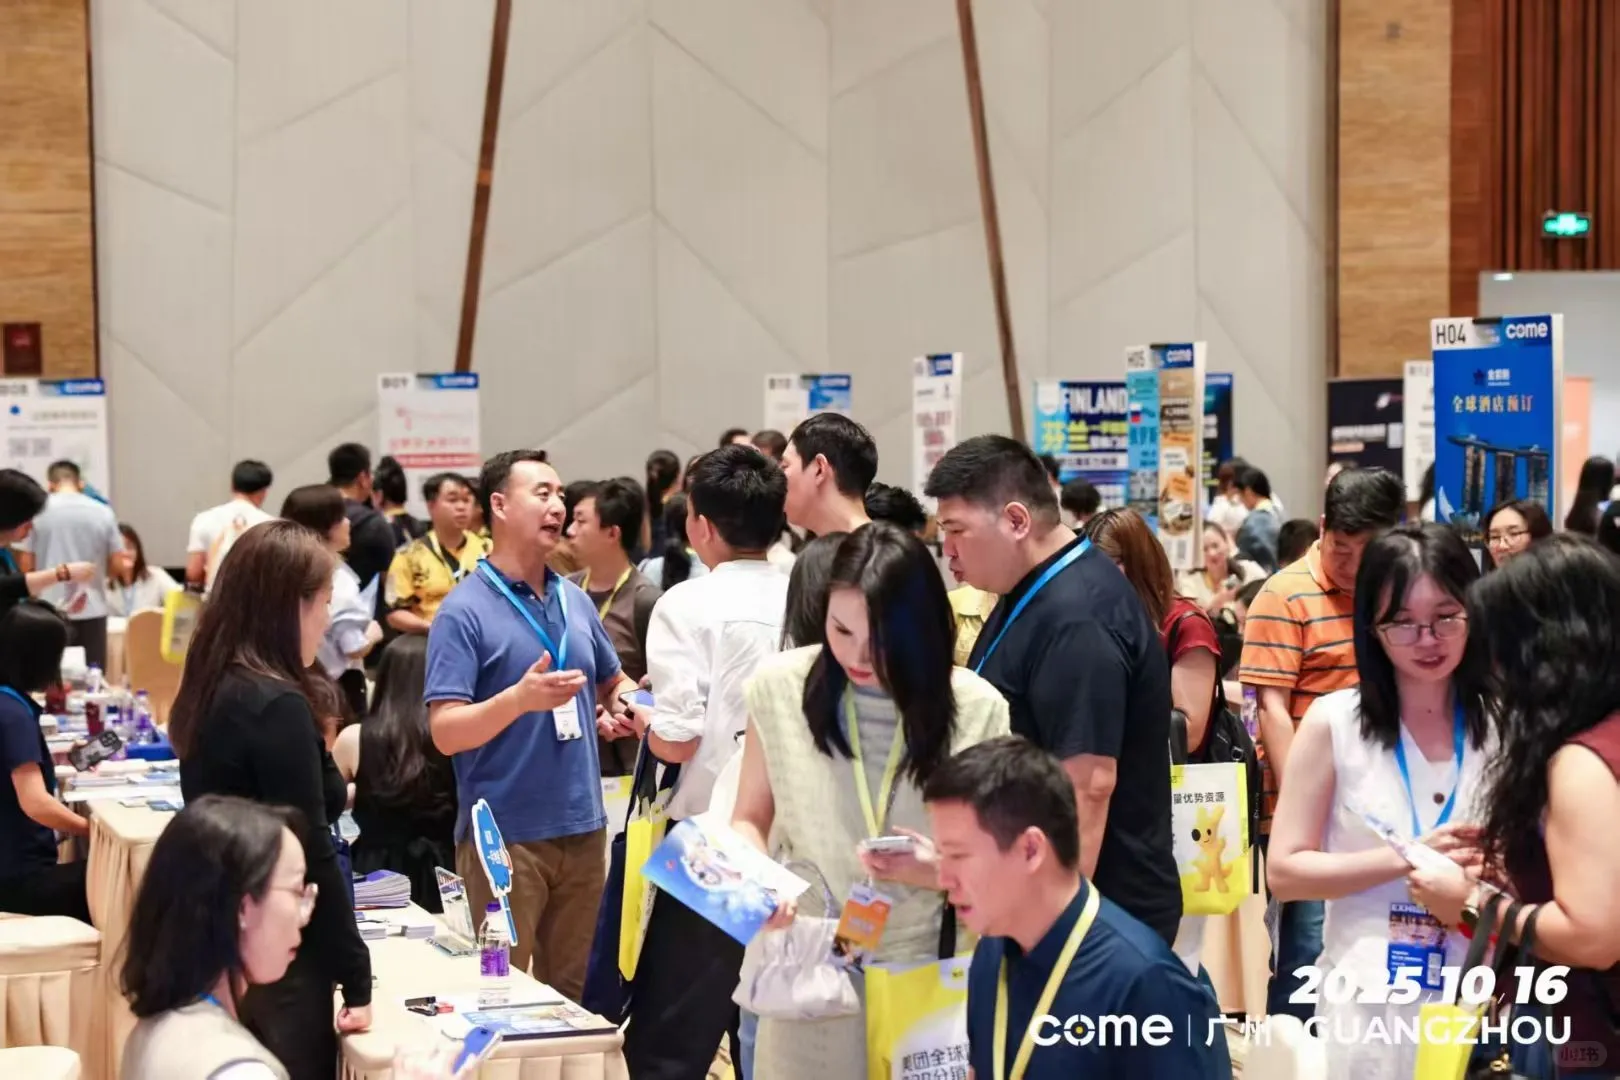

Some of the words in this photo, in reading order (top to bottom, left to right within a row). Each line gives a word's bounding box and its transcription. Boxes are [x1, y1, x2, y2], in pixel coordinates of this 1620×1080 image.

[1436, 324, 1467, 345] H04
[1505, 321, 1549, 340] come
[1060, 386, 1128, 415] FINLAND
[1452, 393, 1534, 414] 全球酒店预订
[1173, 791, 1226, 805] 量优势资源
[902, 1043, 969, 1072] 美团全球
